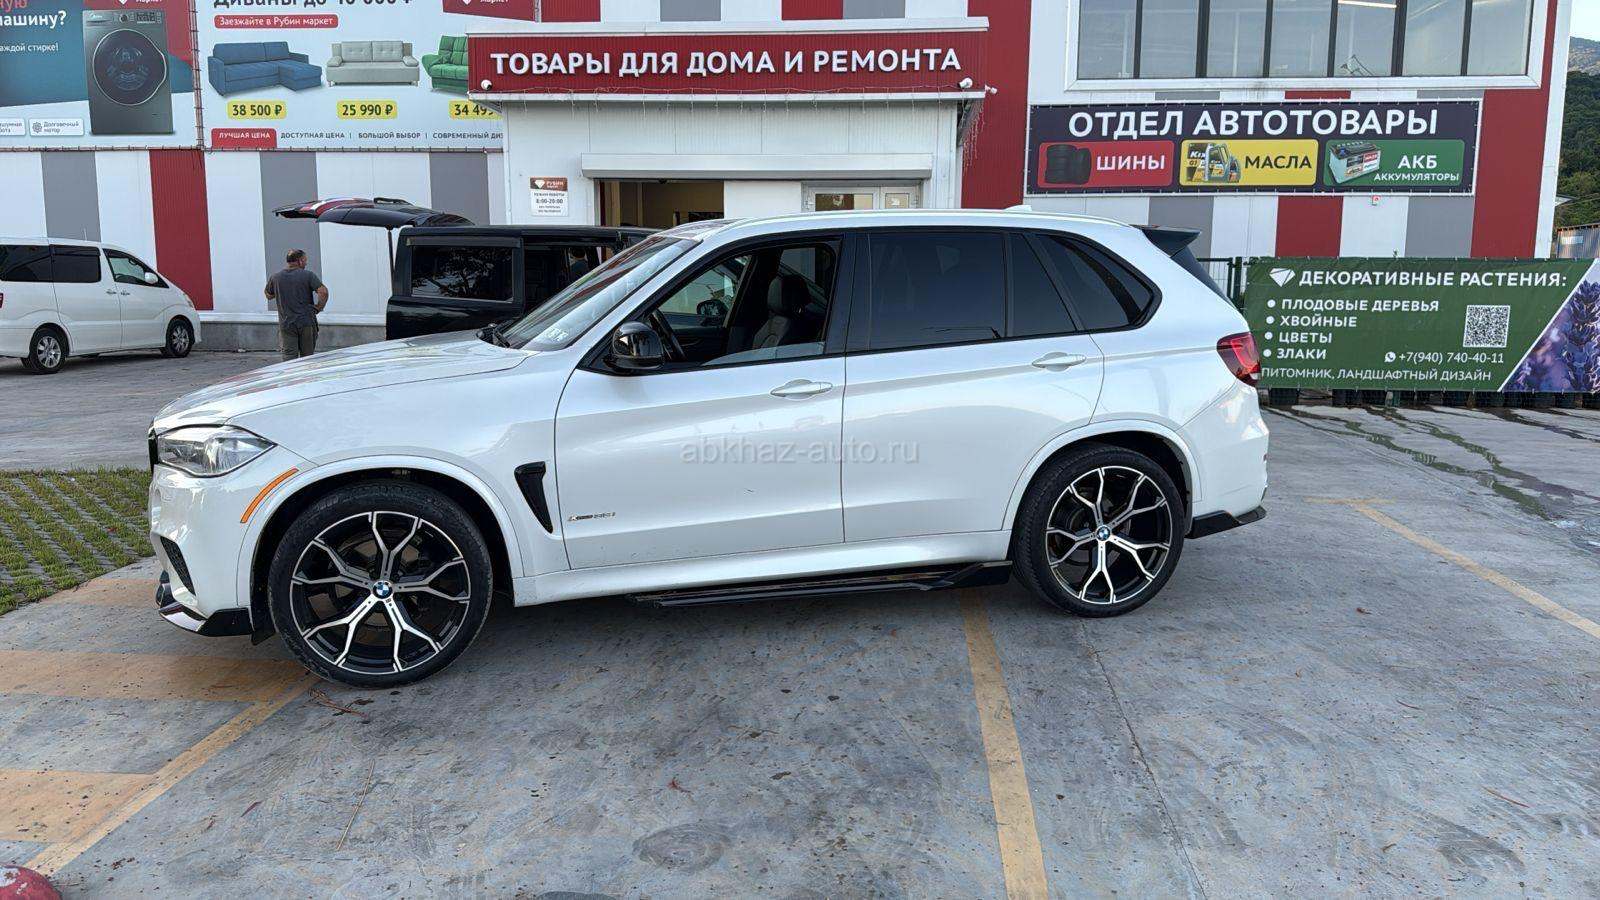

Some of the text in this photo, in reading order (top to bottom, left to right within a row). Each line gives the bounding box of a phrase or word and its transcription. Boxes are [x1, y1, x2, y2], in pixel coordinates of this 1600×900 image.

[0, 10, 67, 29] ашину?
[220, 17, 264, 26] Заезжайте
[273, 17, 301, 27] Рубин
[302, 18, 333, 27] маркет
[27, 42, 59, 53] стирке!
[490, 48, 962, 78] ТОВАРЫ ДЛЯ ДОМА И РЕМОНТА
[232, 104, 247, 116] 38
[250, 104, 271, 116] 500
[342, 104, 356, 116] 25
[359, 104, 382, 116] 990
[454, 104, 494, 116] 34 49
[1069, 109, 1438, 140] ОТДЕЛ АВТОТОВАРЫ
[358, 131, 395, 139] БОЛЬШОЙ
[432, 131, 489, 139] СОВРЕМЕННЫЙ
[1096, 155, 1165, 171] ШИНЫ
[1244, 155, 1312, 170] МАСЛА
[1397, 154, 1438, 169] АКБ
[1373, 172, 1460, 182] АККУМУЛЯТОРЫ
[1299, 271, 1567, 286] ДЕКОРАТИВНЫЕ РАСТЕНИЯ:
[1281, 299, 1439, 312] ПЛОДОВЫЕ ДЕРЕВЬЯ
[1280, 313, 1357, 327] ХВОЙНЫЕ
[1279, 332, 1332, 344] ЦВЕТЫ
[1276, 348, 1327, 359] ЗЛАКИ
[1399, 352, 1504, 365] +7(940) 740-40-11
[1261, 368, 1491, 381] ПИТОМНИК, ЛАНДШАФТНЫЙ ДИЗАЙН
